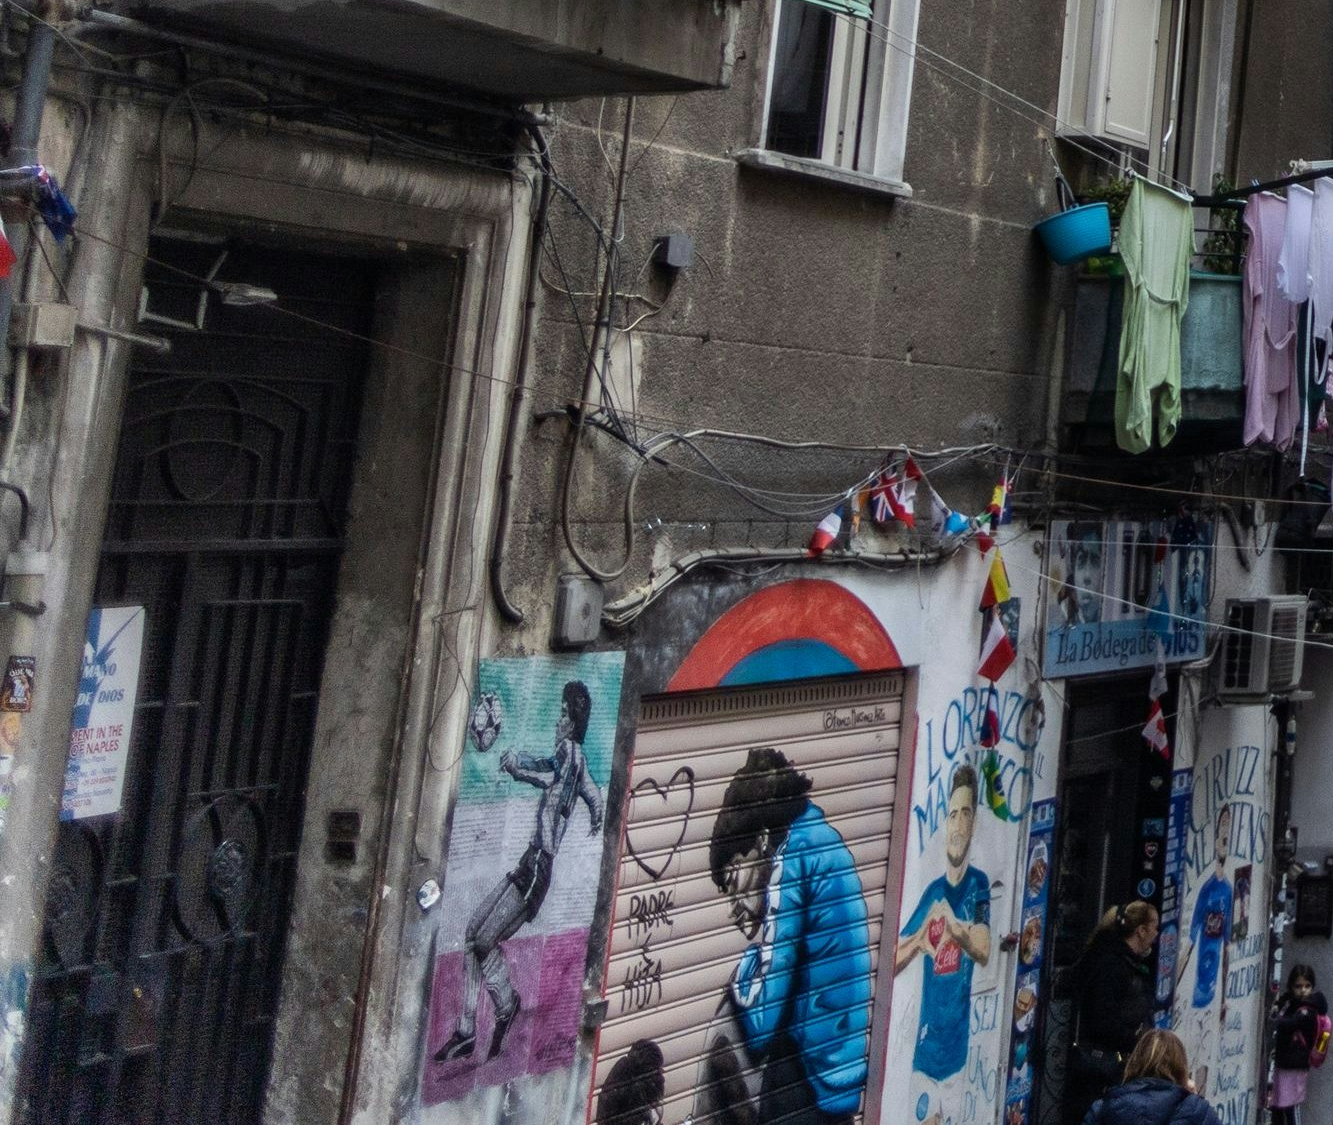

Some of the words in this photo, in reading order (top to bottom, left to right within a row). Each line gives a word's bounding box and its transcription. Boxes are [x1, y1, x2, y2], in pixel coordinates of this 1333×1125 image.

[1056, 633, 1078, 665] La
[1079, 626, 1138, 666] Bodega
[98, 689, 125, 705] DIOS
[86, 740, 120, 755] NAPLES
[628, 890, 673, 939] PADRE
